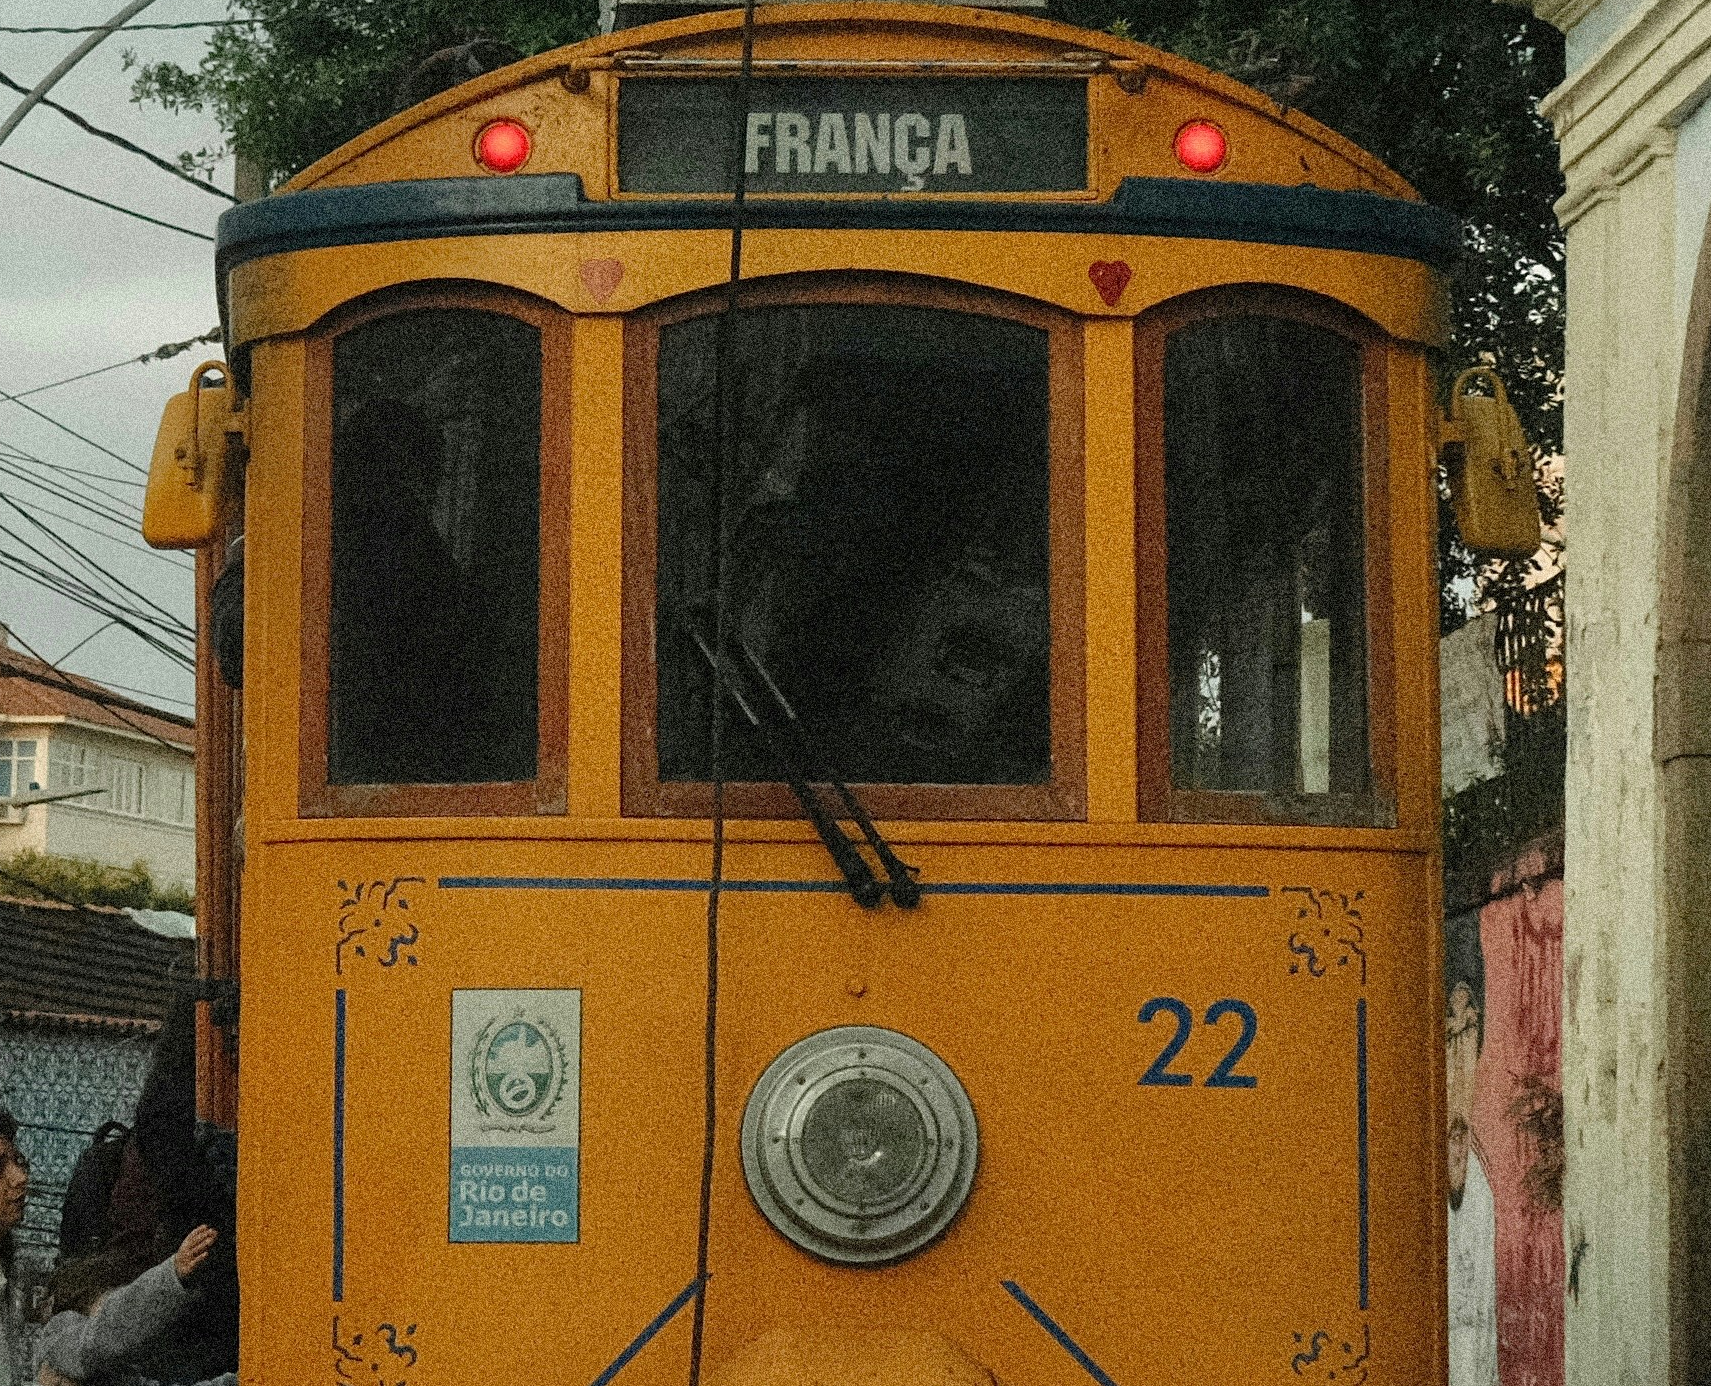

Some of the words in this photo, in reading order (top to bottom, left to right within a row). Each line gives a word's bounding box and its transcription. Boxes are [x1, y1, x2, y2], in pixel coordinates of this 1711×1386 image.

[744, 112, 973, 192] FRANÇA
[1138, 997, 1258, 1088] 22
[460, 1164, 539, 1177] GOVERNO
[545, 1164, 569, 1178] DO
[460, 1179, 506, 1203] Rio
[511, 1179, 547, 1202] de
[459, 1203, 569, 1228] Janeiro
